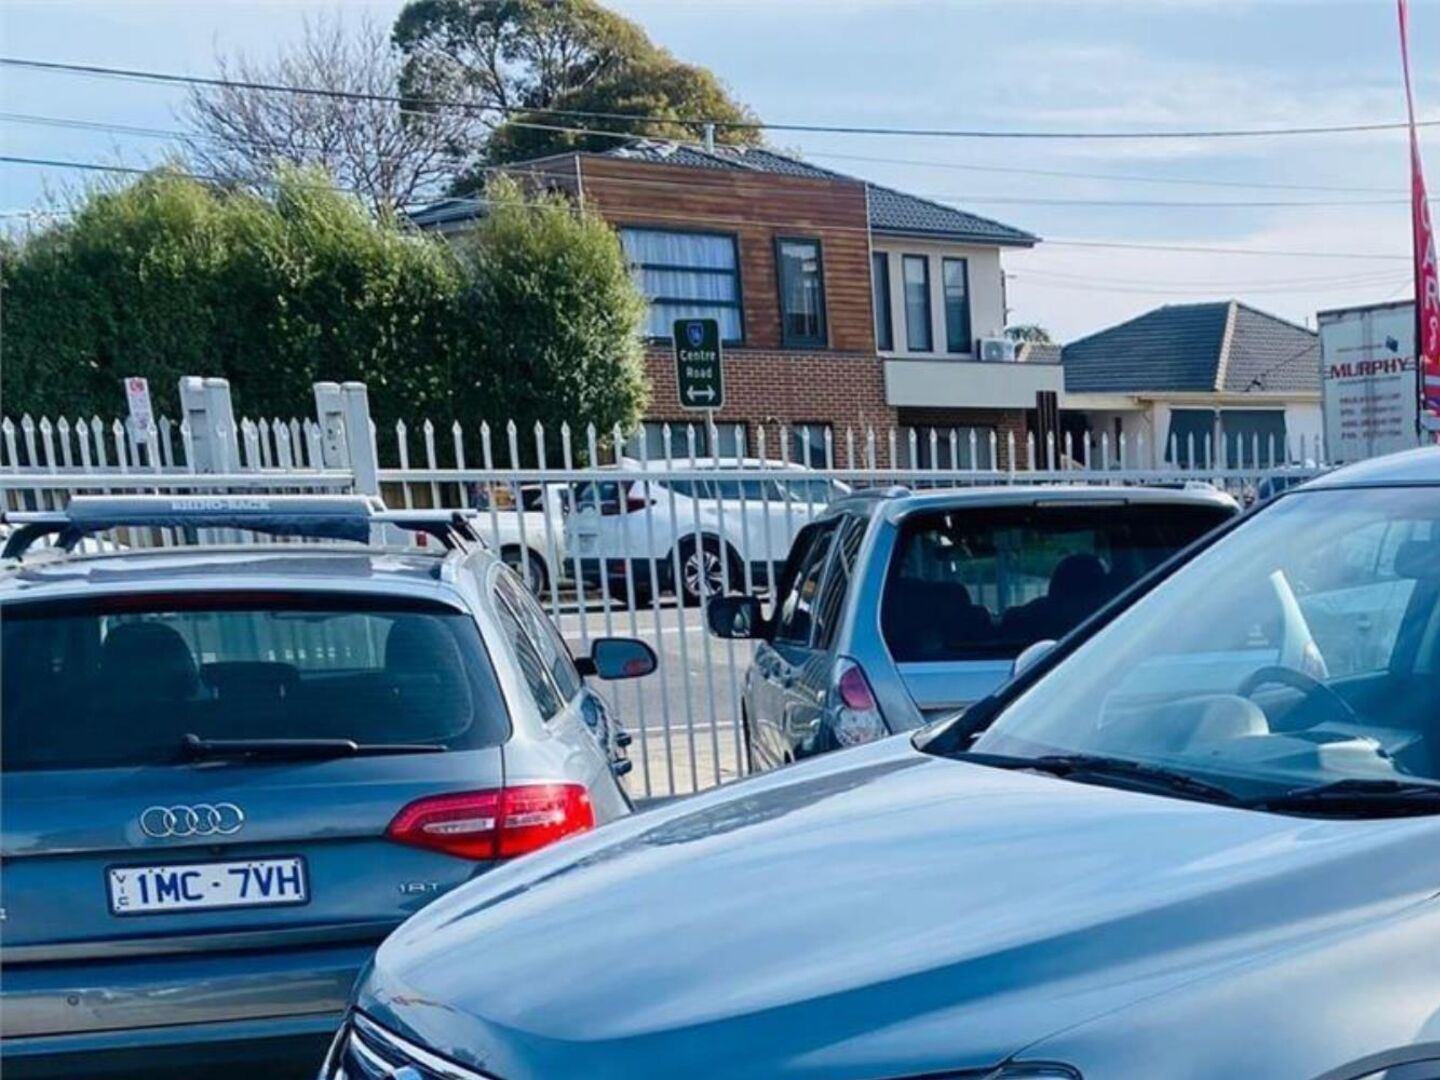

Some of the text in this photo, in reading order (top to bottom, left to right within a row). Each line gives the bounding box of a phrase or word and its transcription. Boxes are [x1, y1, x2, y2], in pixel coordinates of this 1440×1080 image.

[680, 349, 716, 362] Centre
[686, 366, 713, 379] Road
[1330, 357, 1409, 380] MURPHY
